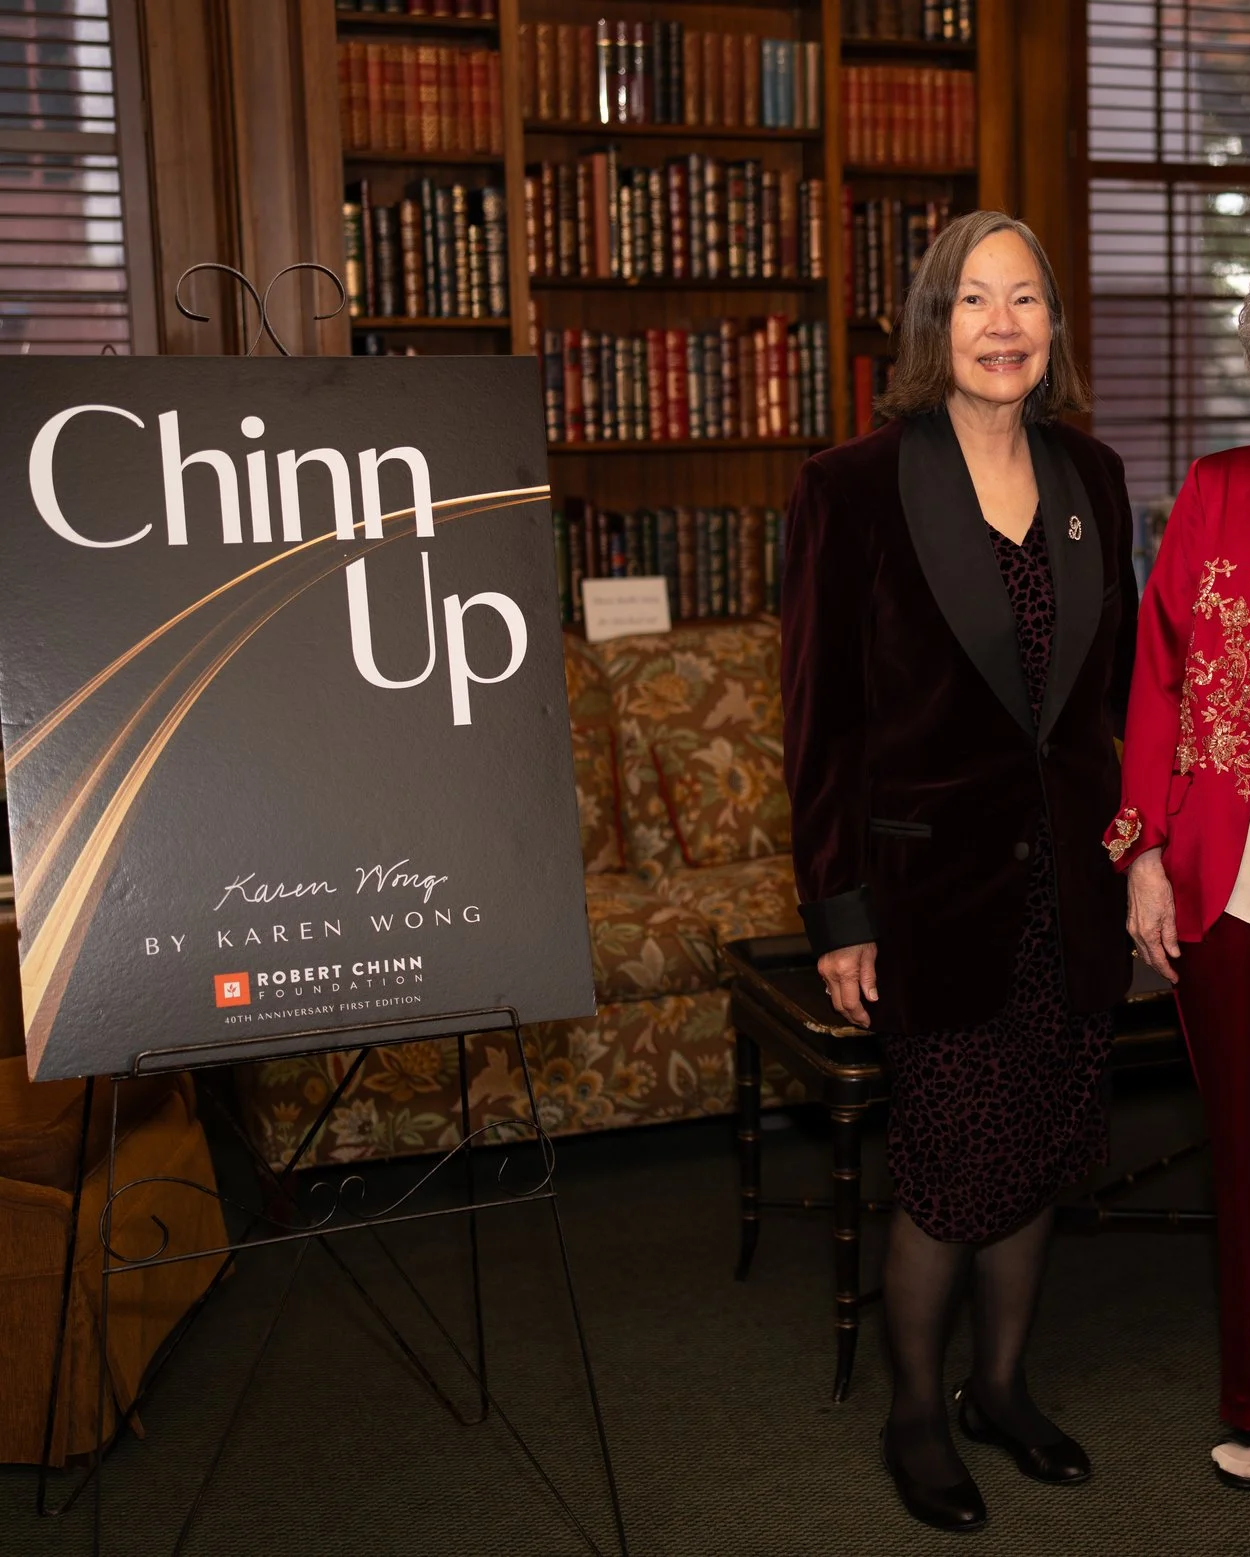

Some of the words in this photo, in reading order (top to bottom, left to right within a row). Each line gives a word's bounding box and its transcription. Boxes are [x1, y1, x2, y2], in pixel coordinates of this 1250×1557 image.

[28, 404, 436, 549] Chinn
[345, 551, 529, 726] Up
[213, 872, 337, 911] Karen
[355, 859, 449, 904] Wong
[145, 934, 186, 956] BY
[217, 919, 342, 949] KAREN
[370, 905, 481, 932] WONG
[257, 964, 342, 987] ROBERT
[352, 956, 423, 976] CHINN
[258, 974, 424, 1000] FOUNDATION
[224, 1013, 252, 1025] 40TH
[257, 1004, 335, 1021] ANNIVERSARY
[340, 1000, 371, 1012] FIRST
[375, 995, 422, 1008] EDITION
